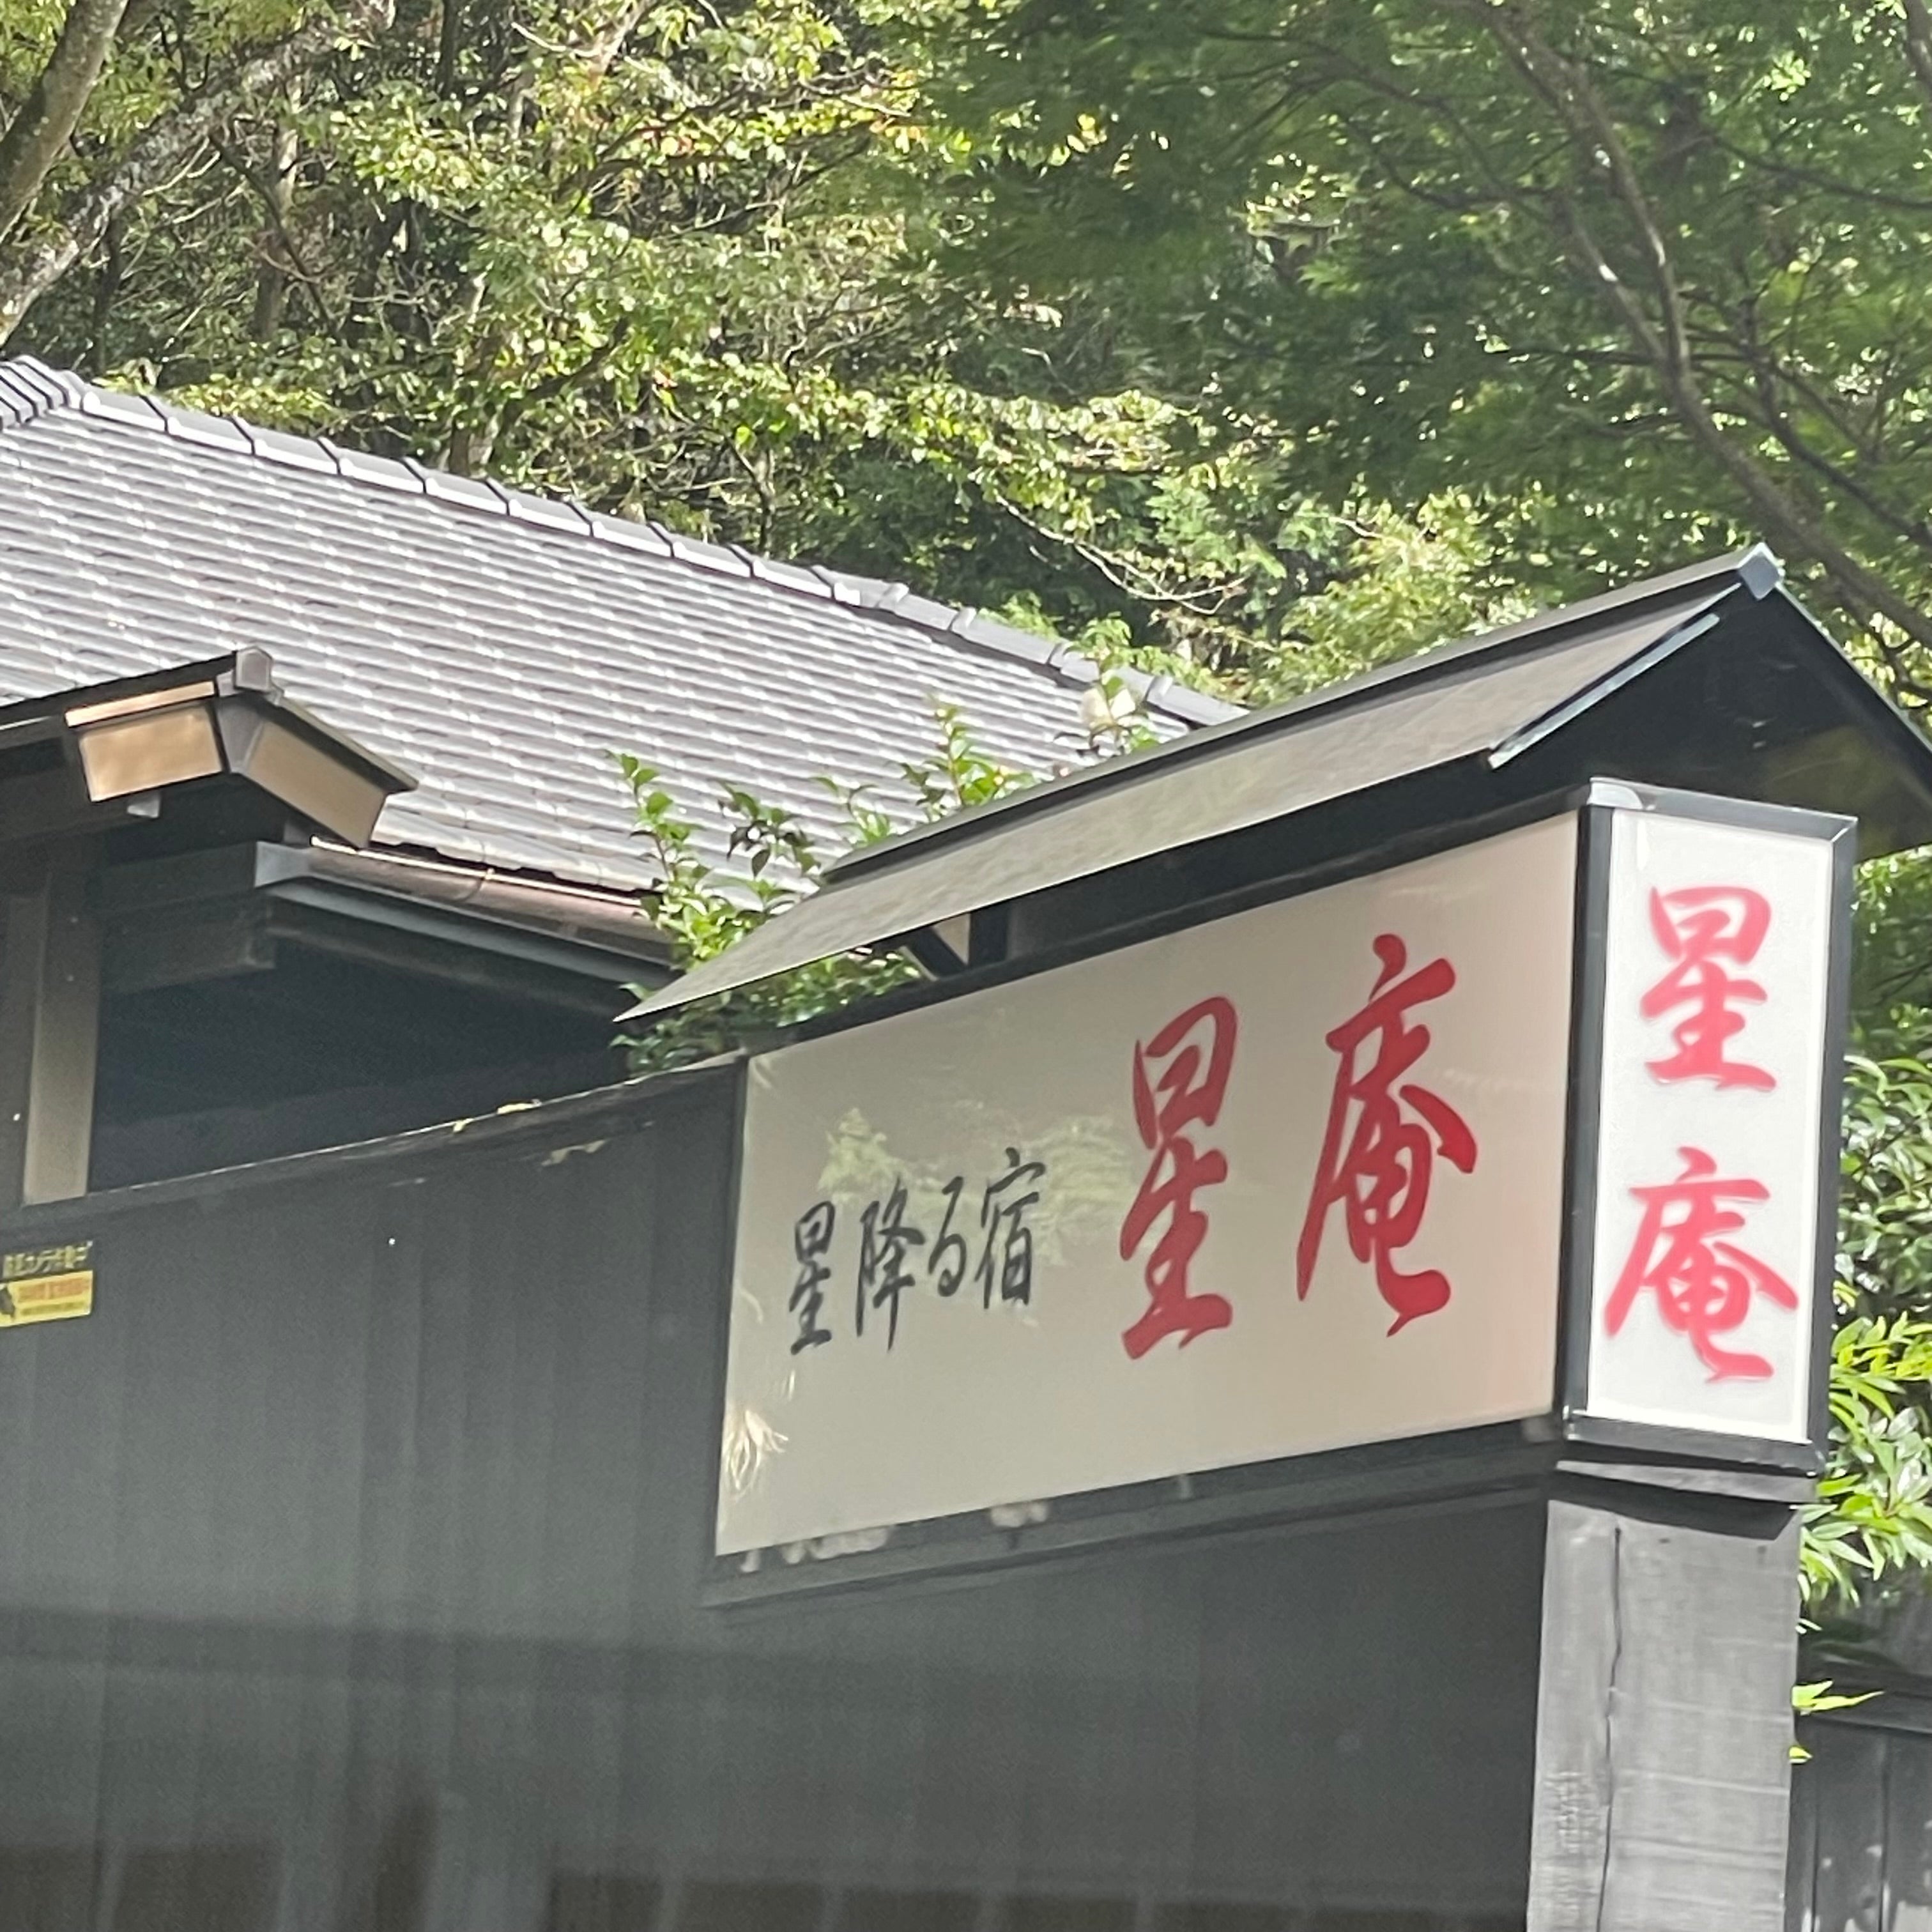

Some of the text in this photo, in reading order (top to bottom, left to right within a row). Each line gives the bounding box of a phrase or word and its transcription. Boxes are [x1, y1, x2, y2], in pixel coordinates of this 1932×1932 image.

[789, 1147, 1046, 1355] 星降る宿
[1119, 933, 1477, 1360] 星庵
[1604, 886, 1798, 1382] 星庵
